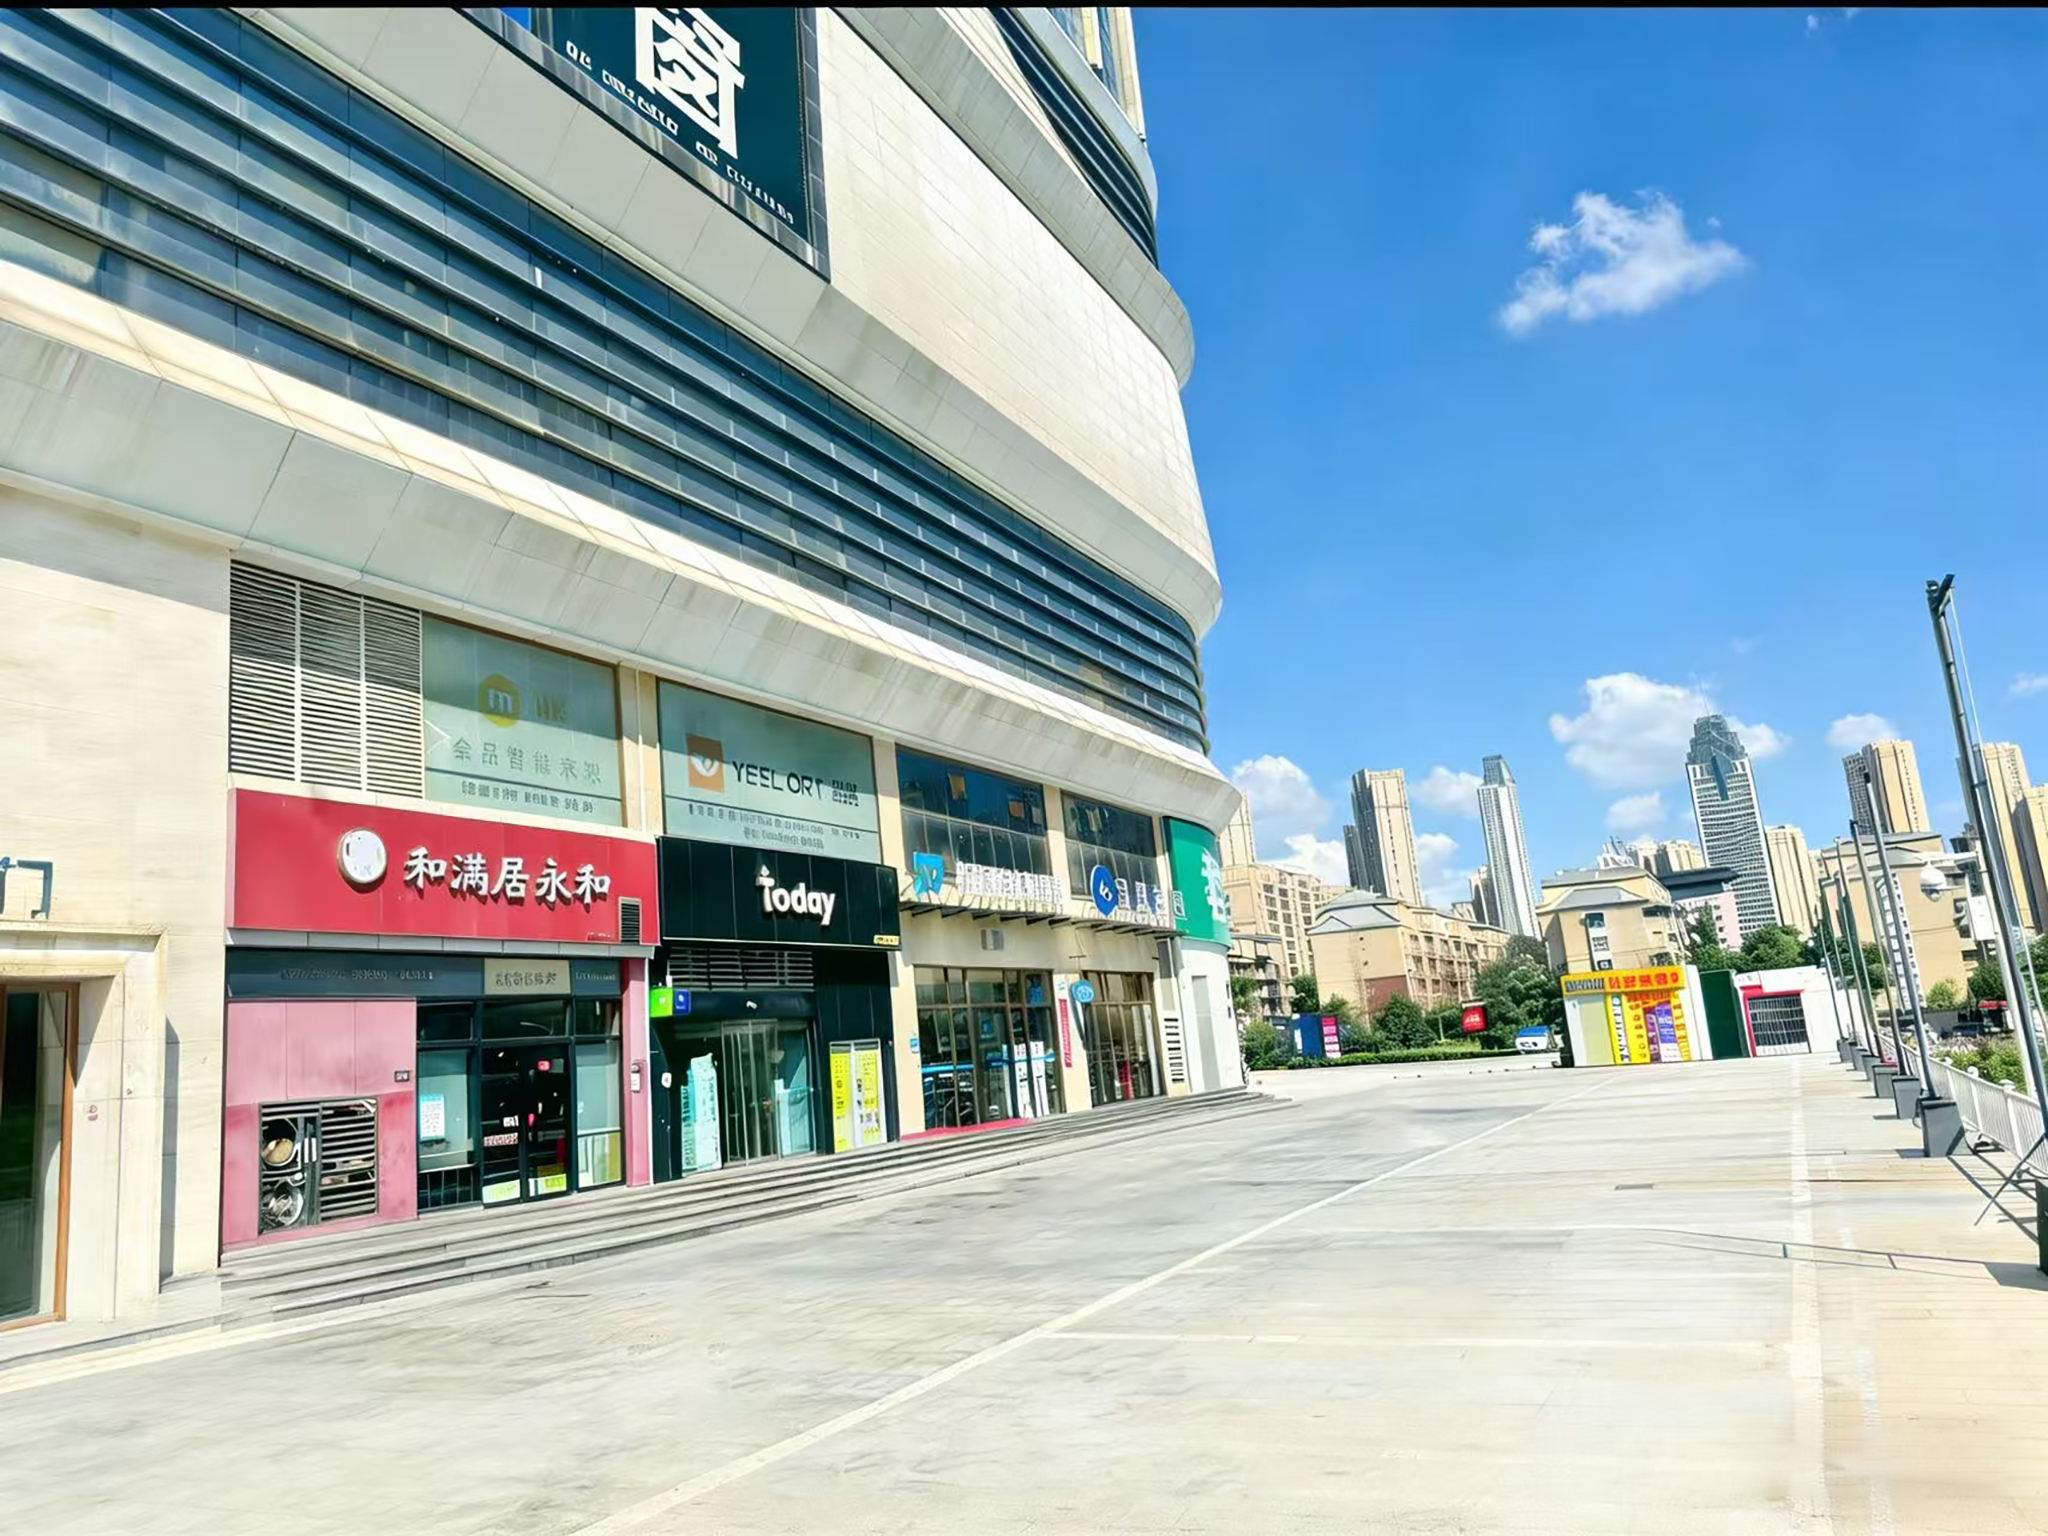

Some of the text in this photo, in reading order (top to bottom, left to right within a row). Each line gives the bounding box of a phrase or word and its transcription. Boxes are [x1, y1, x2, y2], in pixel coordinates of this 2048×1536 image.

[404, 845, 612, 905] 和满居永和
[756, 866, 836, 926] Today
